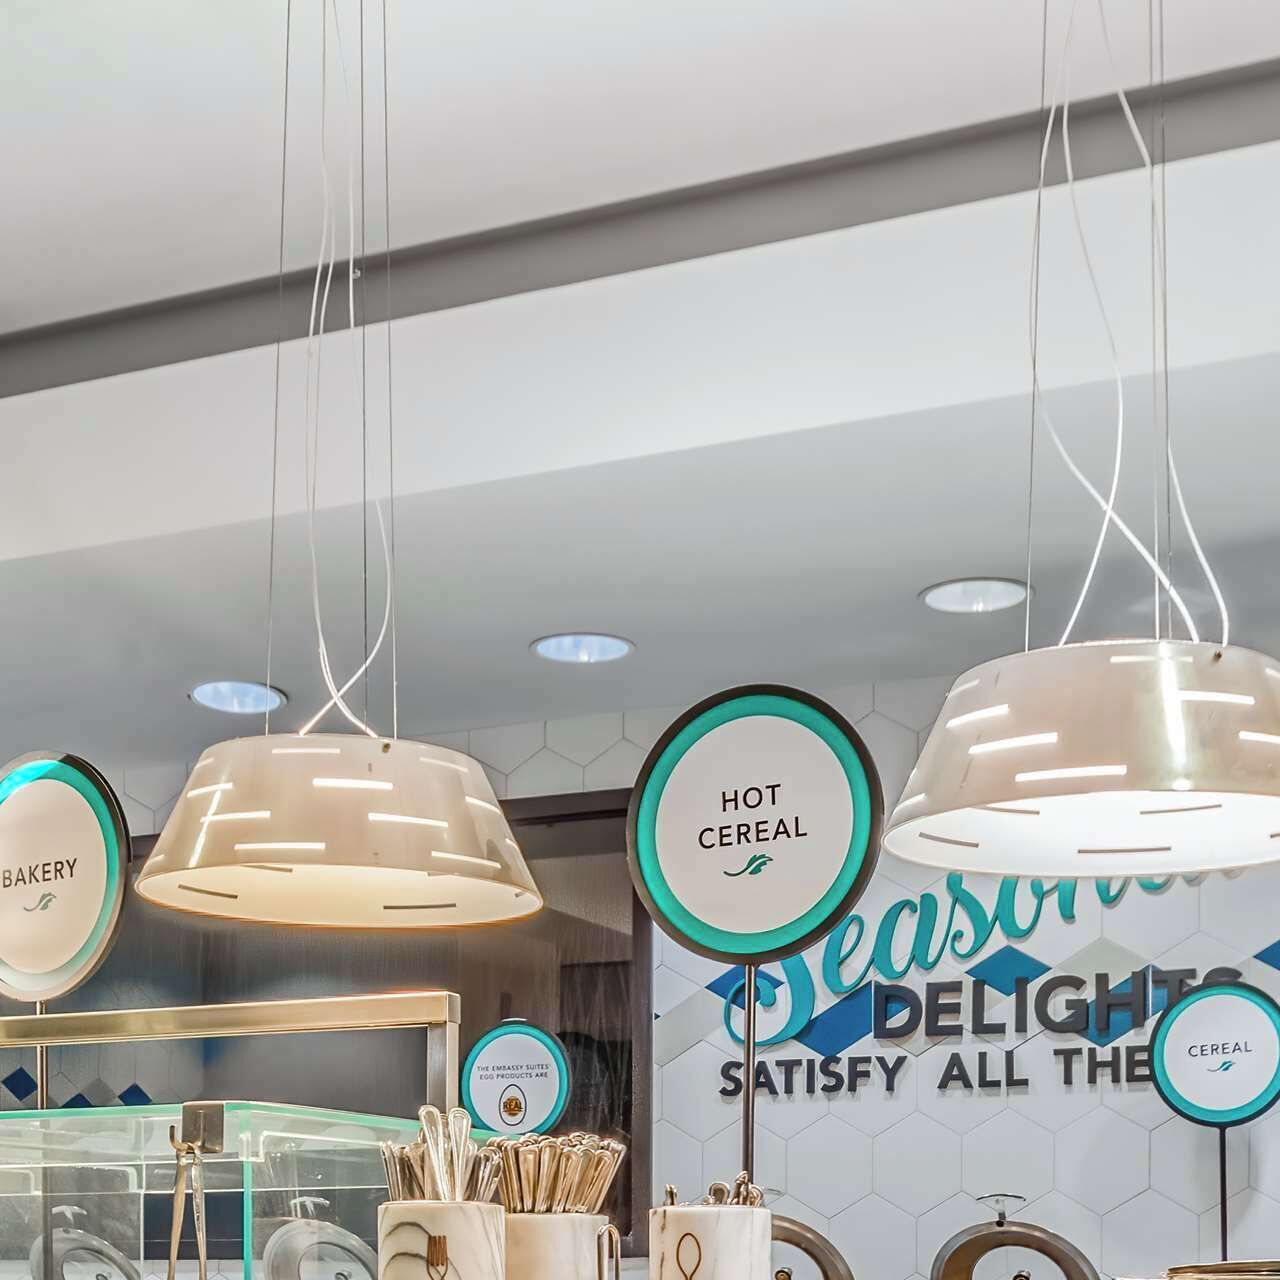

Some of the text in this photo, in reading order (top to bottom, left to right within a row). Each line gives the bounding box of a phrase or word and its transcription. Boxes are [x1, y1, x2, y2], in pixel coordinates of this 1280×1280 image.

[721, 783, 781, 812] HOT
[698, 816, 808, 849] CEREAL
[2, 857, 78, 888] BAKERY
[723, 871, 1240, 1047] Seaso
[873, 966, 1243, 1039] DELIGHT
[1188, 1041, 1253, 1057] CEREAL
[492, 1064, 524, 1072] EMBASSY
[496, 1072, 533, 1080] PRODUCTS
[719, 1055, 908, 1096] SATISFY
[937, 1050, 1029, 1089] ALL
[1053, 1045, 1155, 1085] THE
